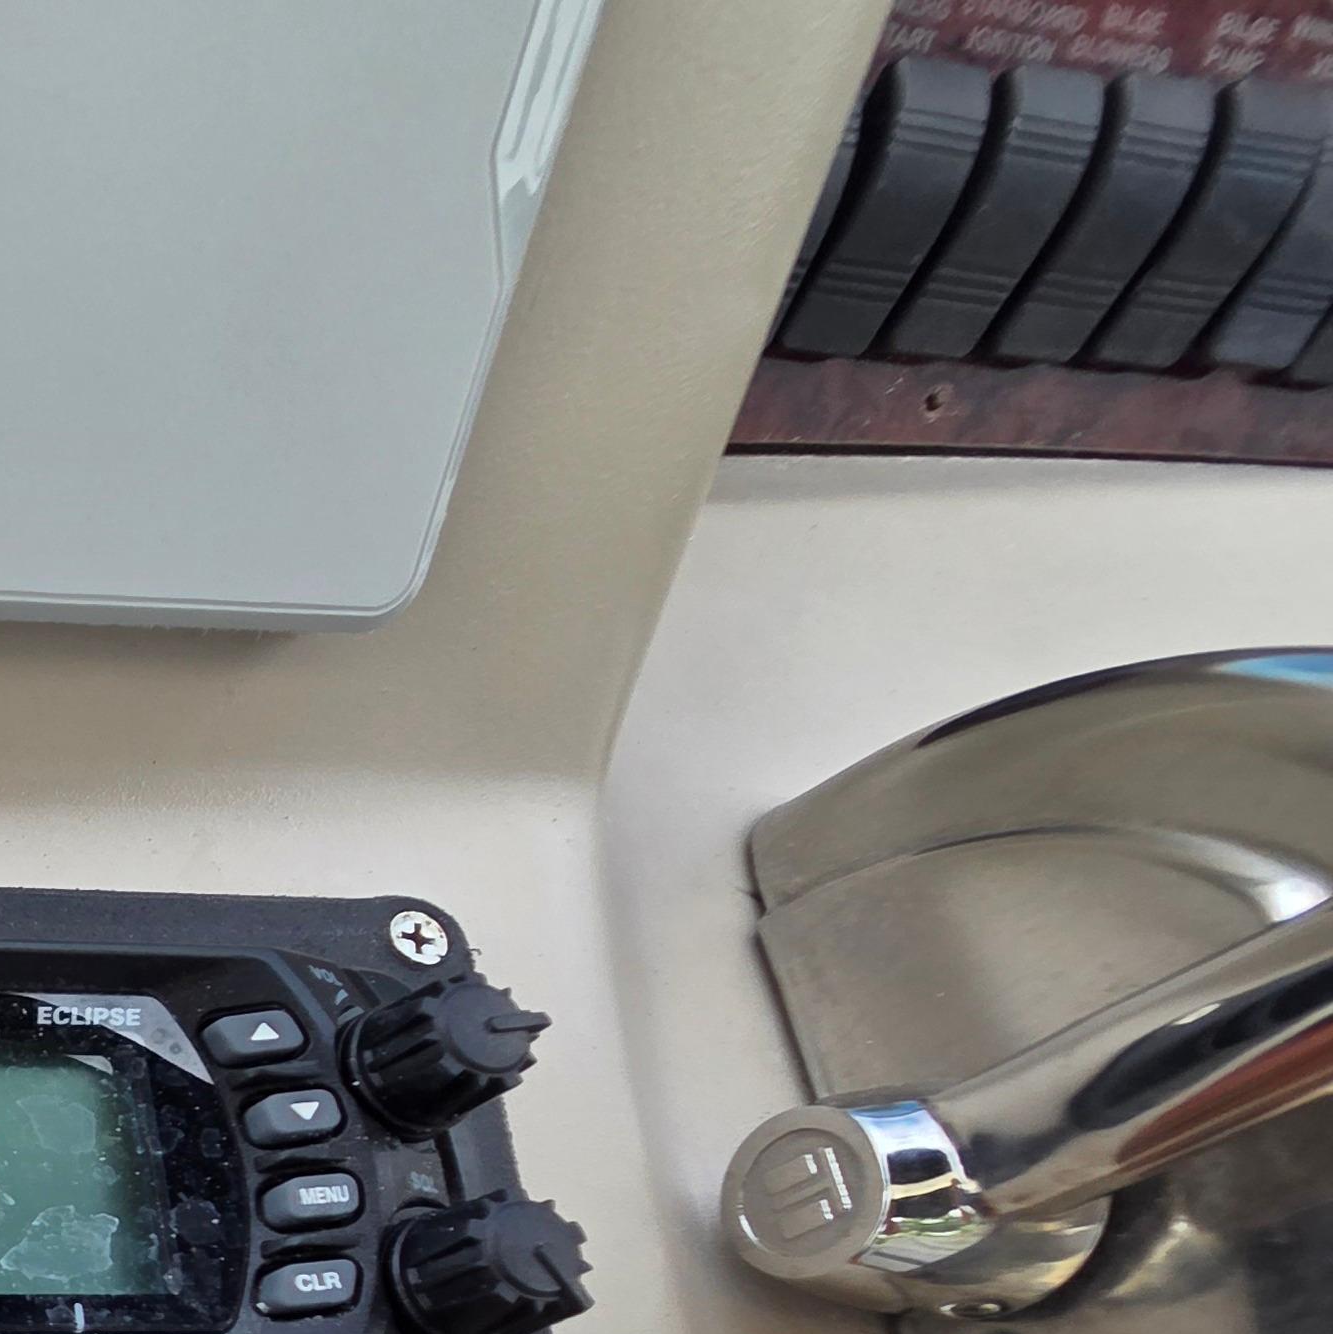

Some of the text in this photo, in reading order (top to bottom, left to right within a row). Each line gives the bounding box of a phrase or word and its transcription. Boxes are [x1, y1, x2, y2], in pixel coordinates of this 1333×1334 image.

[1100, 3, 1168, 36] BILGE
[1215, 12, 1282, 46] BILGE
[36, 1005, 141, 1027] ECLIPSE
[298, 1185, 349, 1206] MENU
[294, 1271, 343, 1292] CLR
